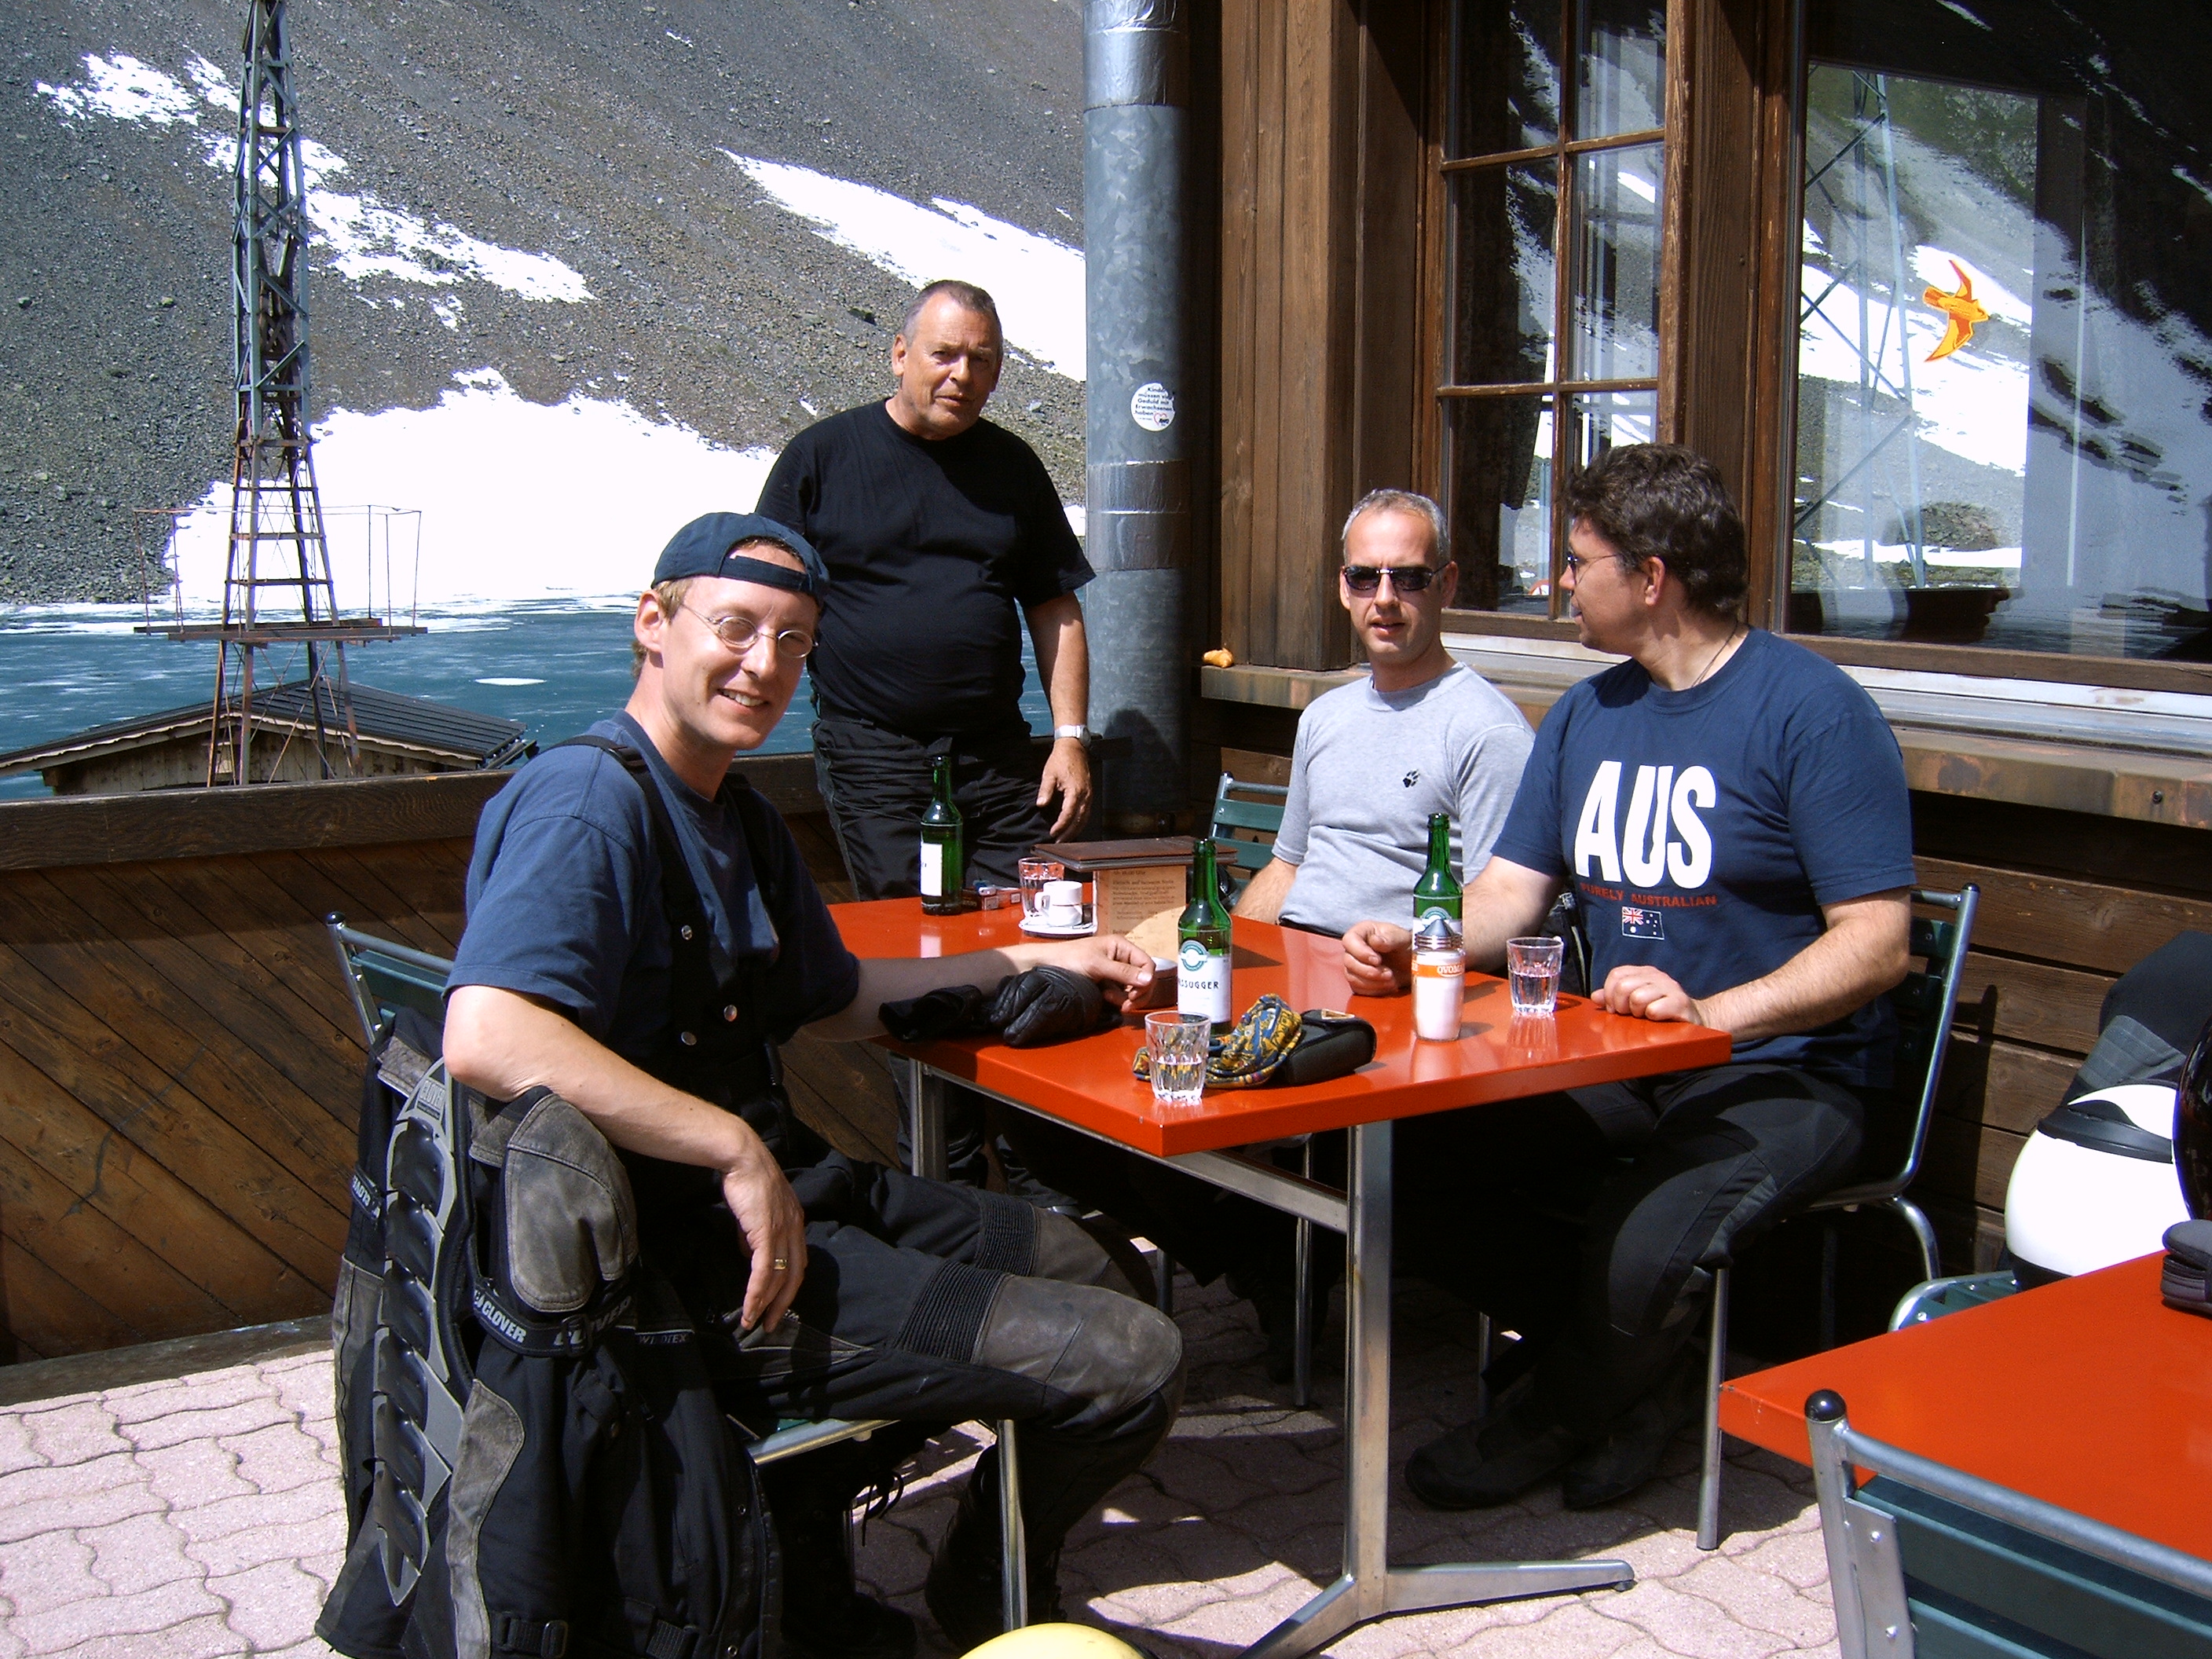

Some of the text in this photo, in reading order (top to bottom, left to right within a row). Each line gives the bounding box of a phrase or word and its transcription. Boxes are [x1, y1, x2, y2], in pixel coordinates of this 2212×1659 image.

[1574, 760, 1716, 888] AUS
[1580, 882, 1717, 907] PURELY AUSTRALIAN
[482, 1300, 527, 1343] CLOVER
